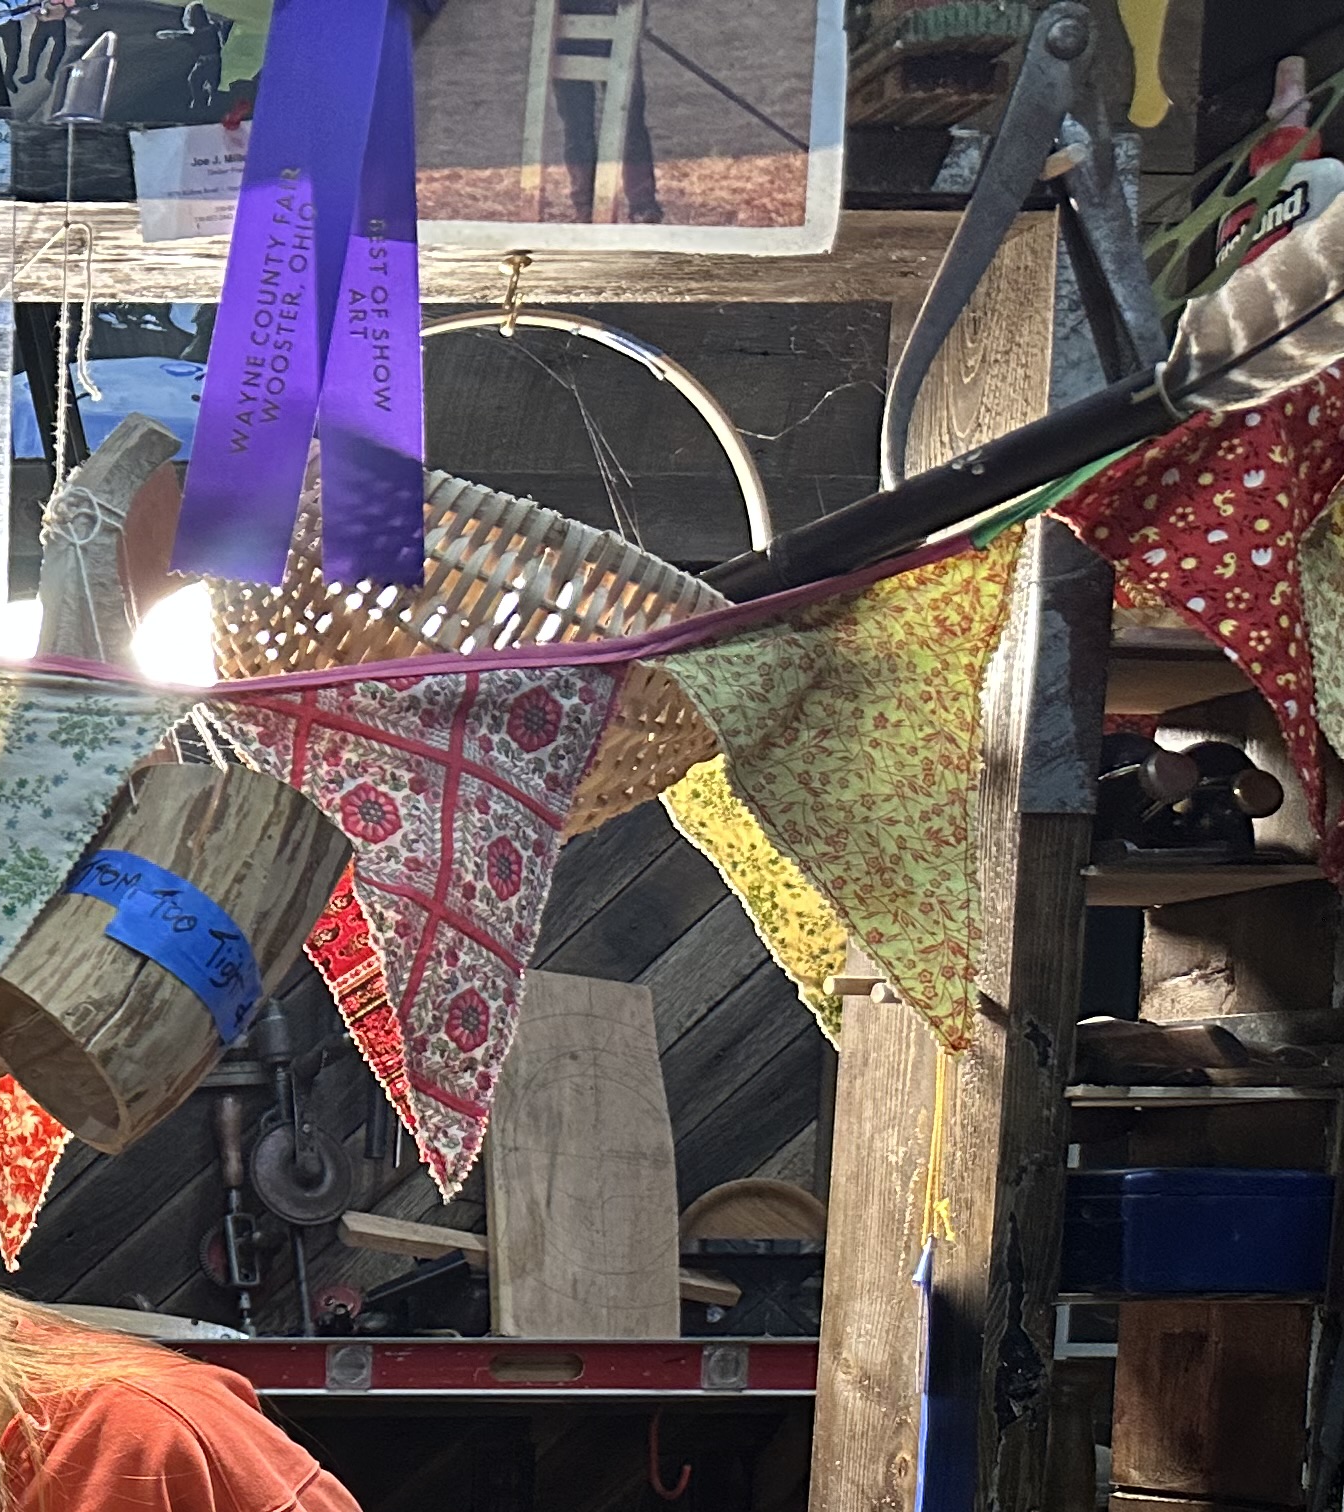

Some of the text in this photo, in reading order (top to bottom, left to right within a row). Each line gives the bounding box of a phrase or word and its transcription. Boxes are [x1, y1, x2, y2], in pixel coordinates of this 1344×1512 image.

[230, 167, 302, 455] WAYNE COUNTY FAIR
[258, 202, 317, 424] WOOSTER, OHIO
[348, 288, 369, 341] ART
[368, 219, 393, 413] BEST OF SHOW
